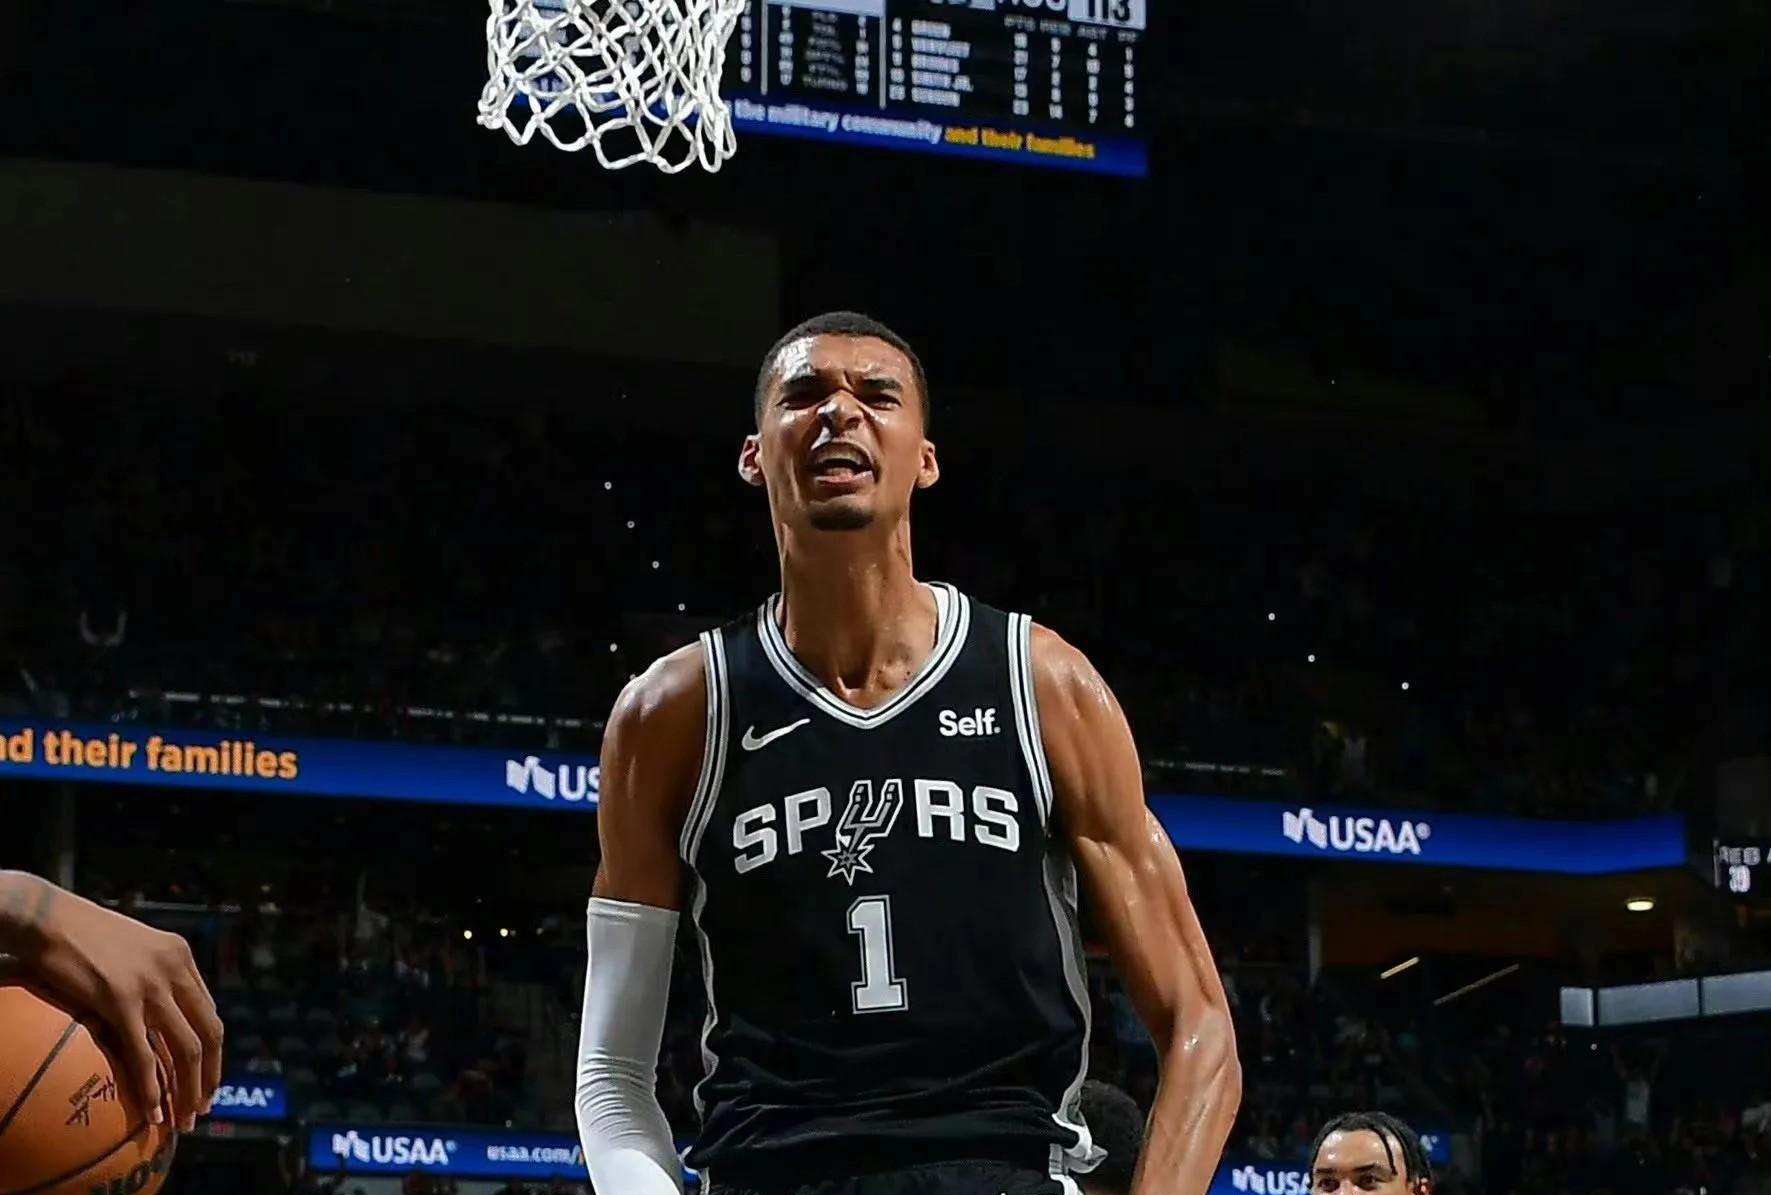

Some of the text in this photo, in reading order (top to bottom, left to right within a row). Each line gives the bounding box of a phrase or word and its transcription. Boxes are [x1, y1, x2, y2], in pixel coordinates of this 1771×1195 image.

[44, 731, 137, 768] their
[146, 736, 297, 779] families
[732, 778, 1020, 886] SPURS
[846, 894, 909, 1015] 1
